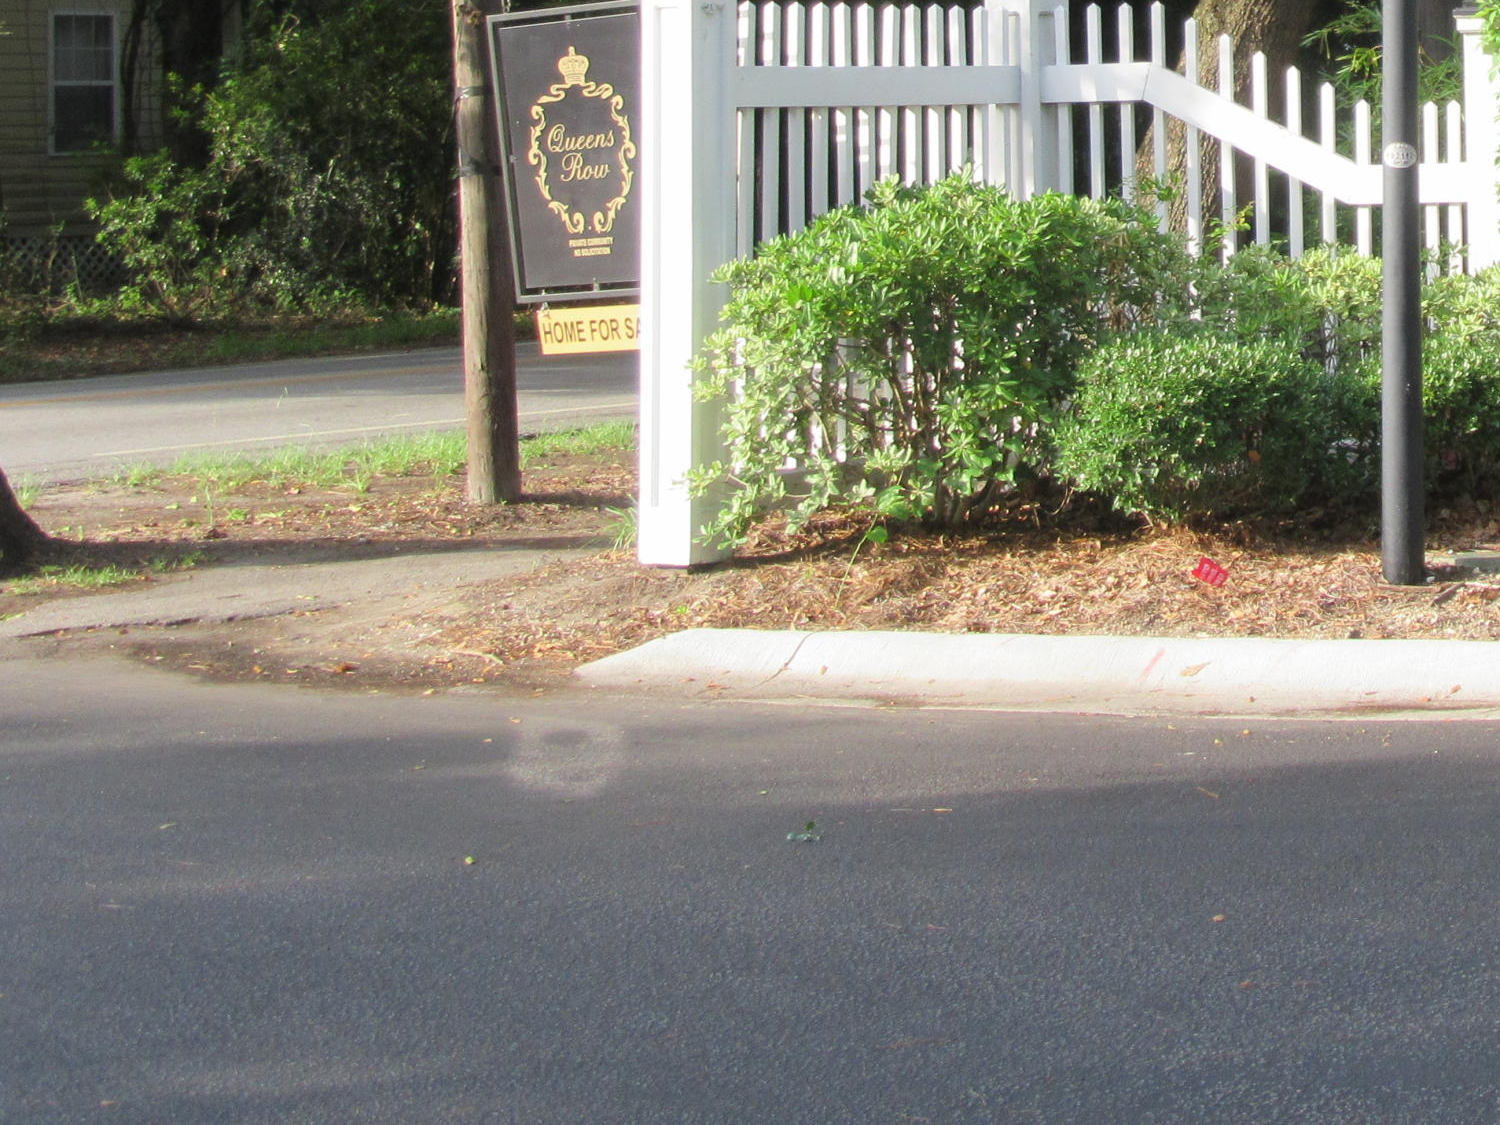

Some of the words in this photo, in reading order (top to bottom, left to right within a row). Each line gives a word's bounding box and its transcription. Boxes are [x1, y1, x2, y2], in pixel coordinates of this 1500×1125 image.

[547, 123, 615, 152] Queens
[560, 152, 611, 181] Row
[542, 320, 586, 344] HOME
[589, 318, 621, 342] FOR
